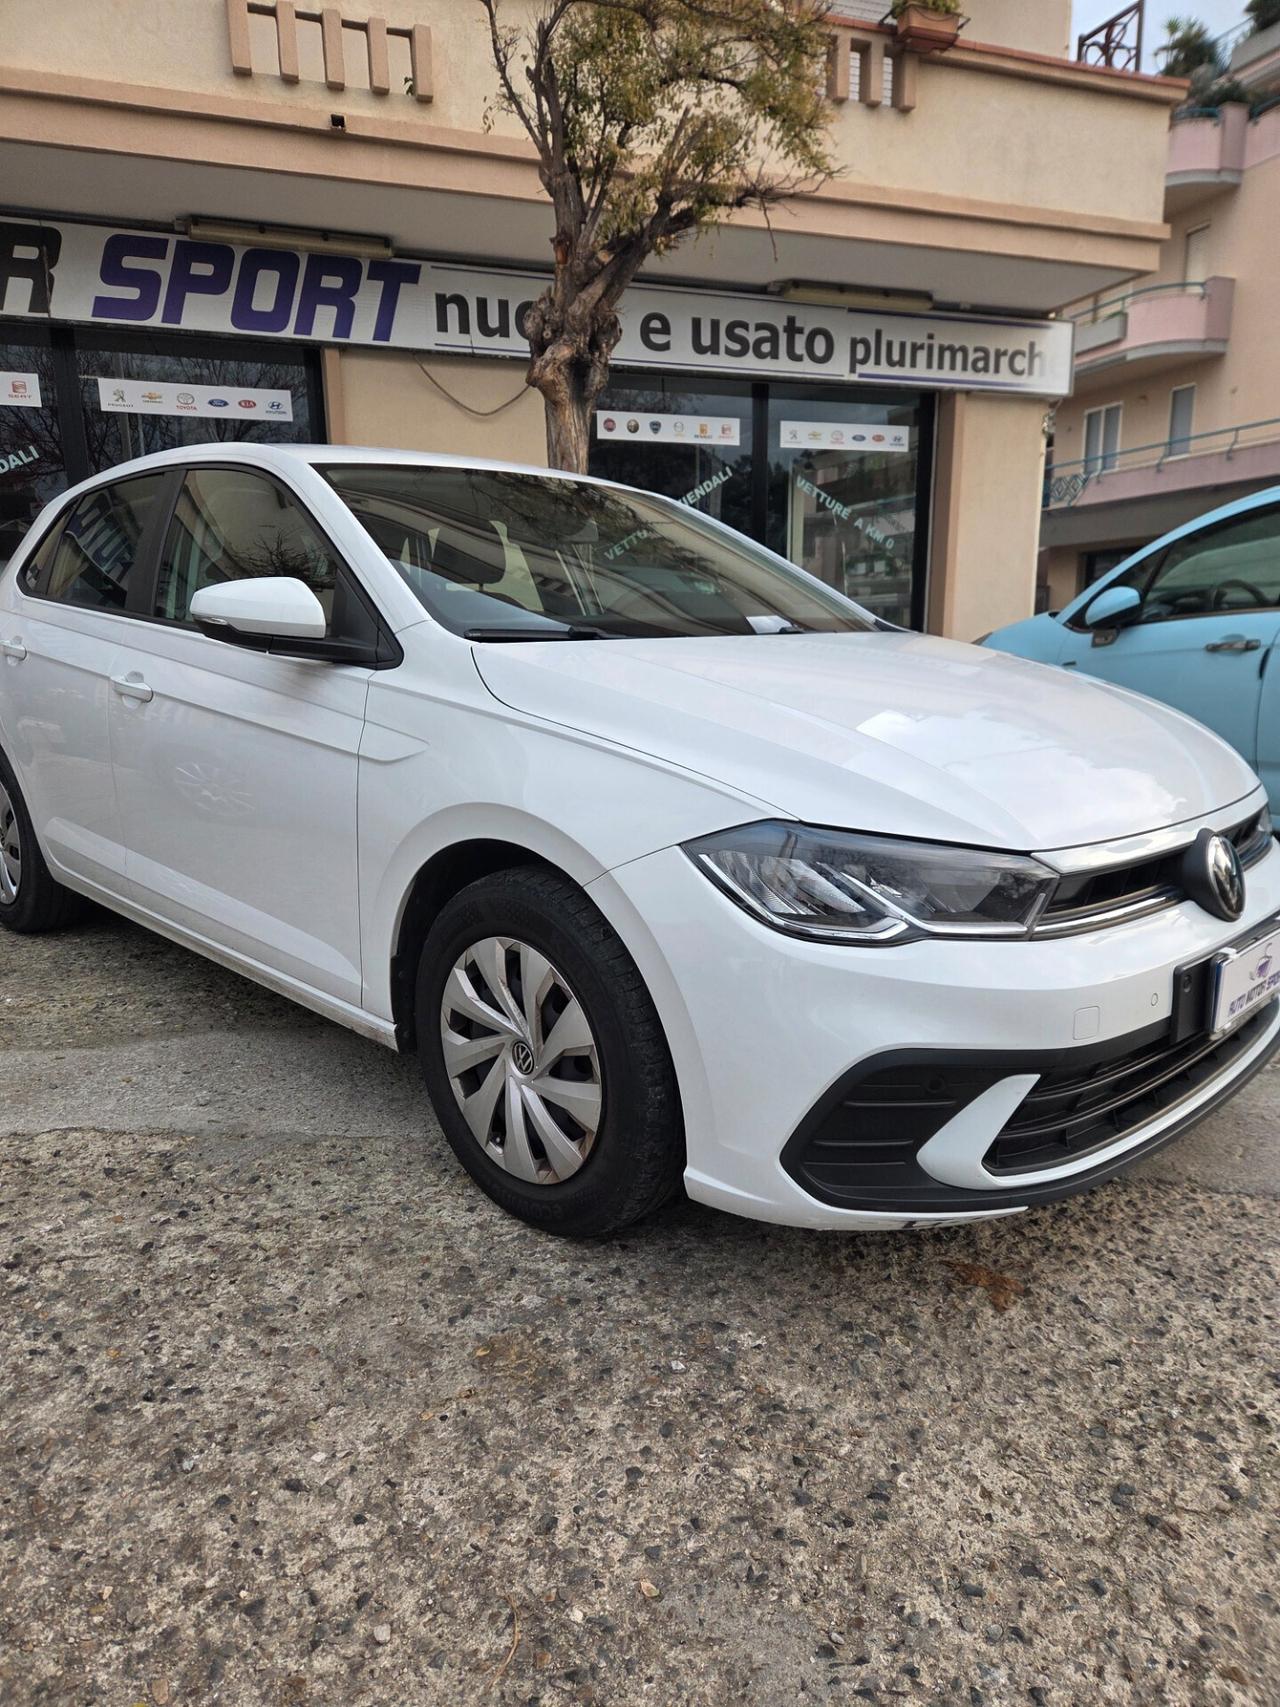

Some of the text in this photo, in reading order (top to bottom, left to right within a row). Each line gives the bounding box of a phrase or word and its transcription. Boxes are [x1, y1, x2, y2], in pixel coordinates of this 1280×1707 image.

[91, 233, 422, 342] SPORT
[640, 311, 672, 352] e
[691, 314, 835, 365] usato
[796, 475, 852, 520] VETTURE
[854, 517, 864, 530] A
[865, 523, 886, 544] KM
